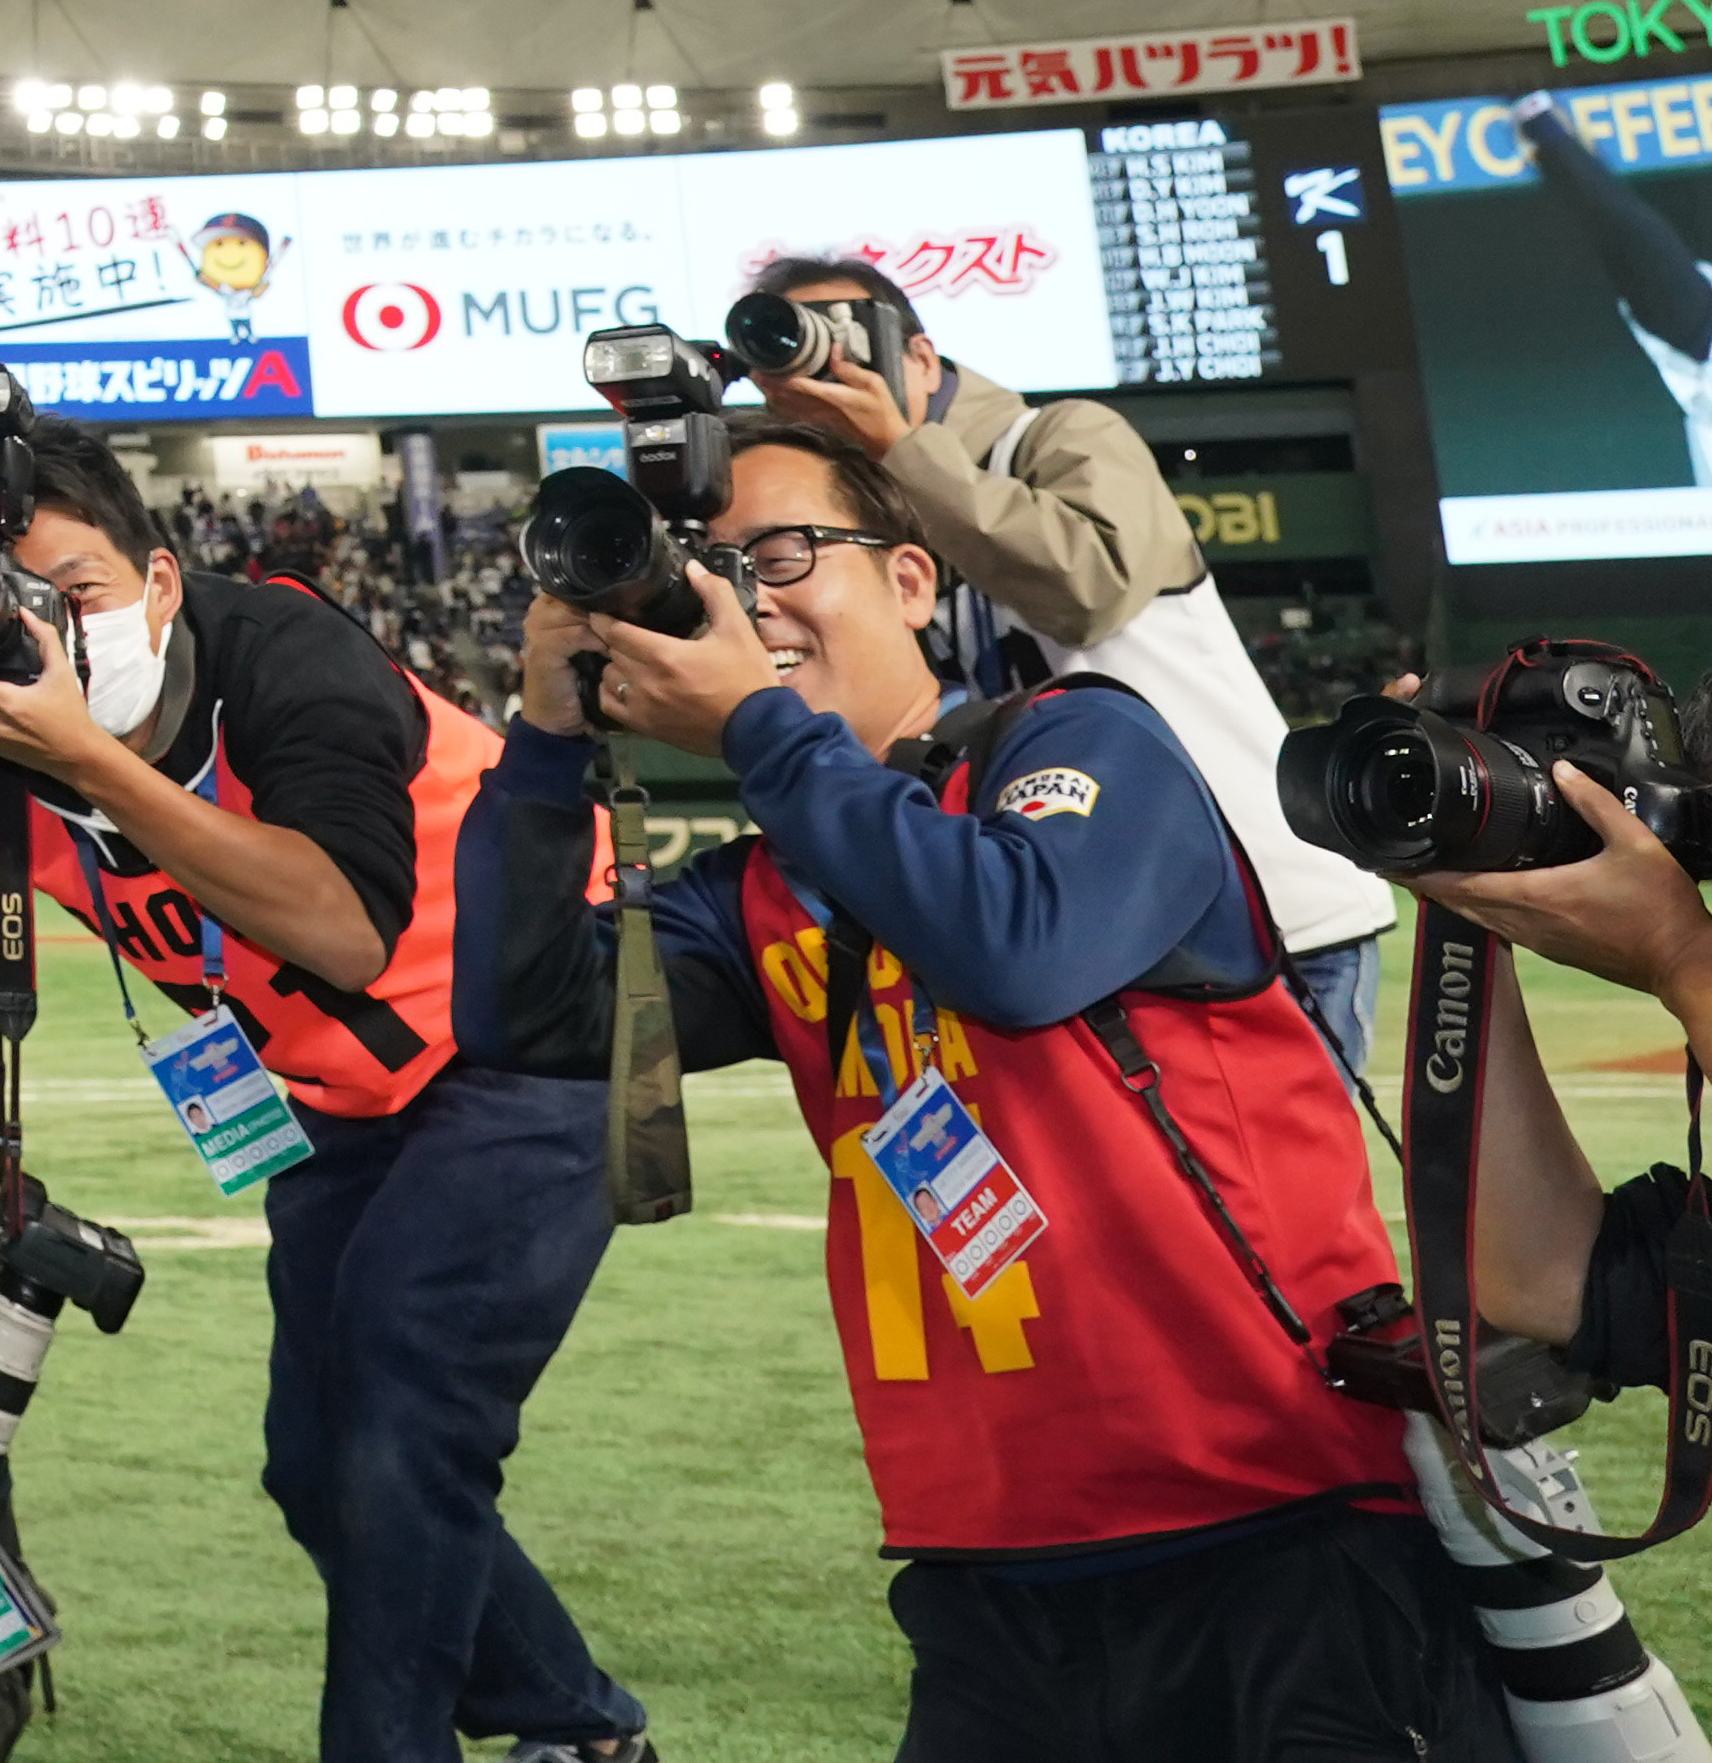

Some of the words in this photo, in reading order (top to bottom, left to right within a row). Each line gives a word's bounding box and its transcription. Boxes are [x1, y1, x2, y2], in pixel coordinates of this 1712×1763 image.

[952, 24, 1354, 103] 元気ハツラツ!
[1101, 120, 1227, 153] KOREA
[1173, 149, 1224, 174] KIM
[1175, 173, 1226, 196] KIM
[1179, 194, 1249, 219] YOON
[342, 220, 654, 254] 世界が進むチカラになる。
[1315, 229, 1350, 286] 1
[1193, 263, 1245, 287] KIM
[462, 286, 660, 336] MUFG
[1196, 286, 1248, 310] KIM
[1194, 306, 1267, 333] PARK
[1197, 330, 1260, 356] CHOI
[1197, 354, 1262, 381] CHOI
[1004, 782, 1088, 807] JAPAN
[1, 892, 24, 962] EOS
[1427, 940, 1475, 1095] Canon
[202, 1122, 251, 1156] MEDIA
[949, 1186, 998, 1236] TEAM
[1684, 1340, 1712, 1446] EOS
